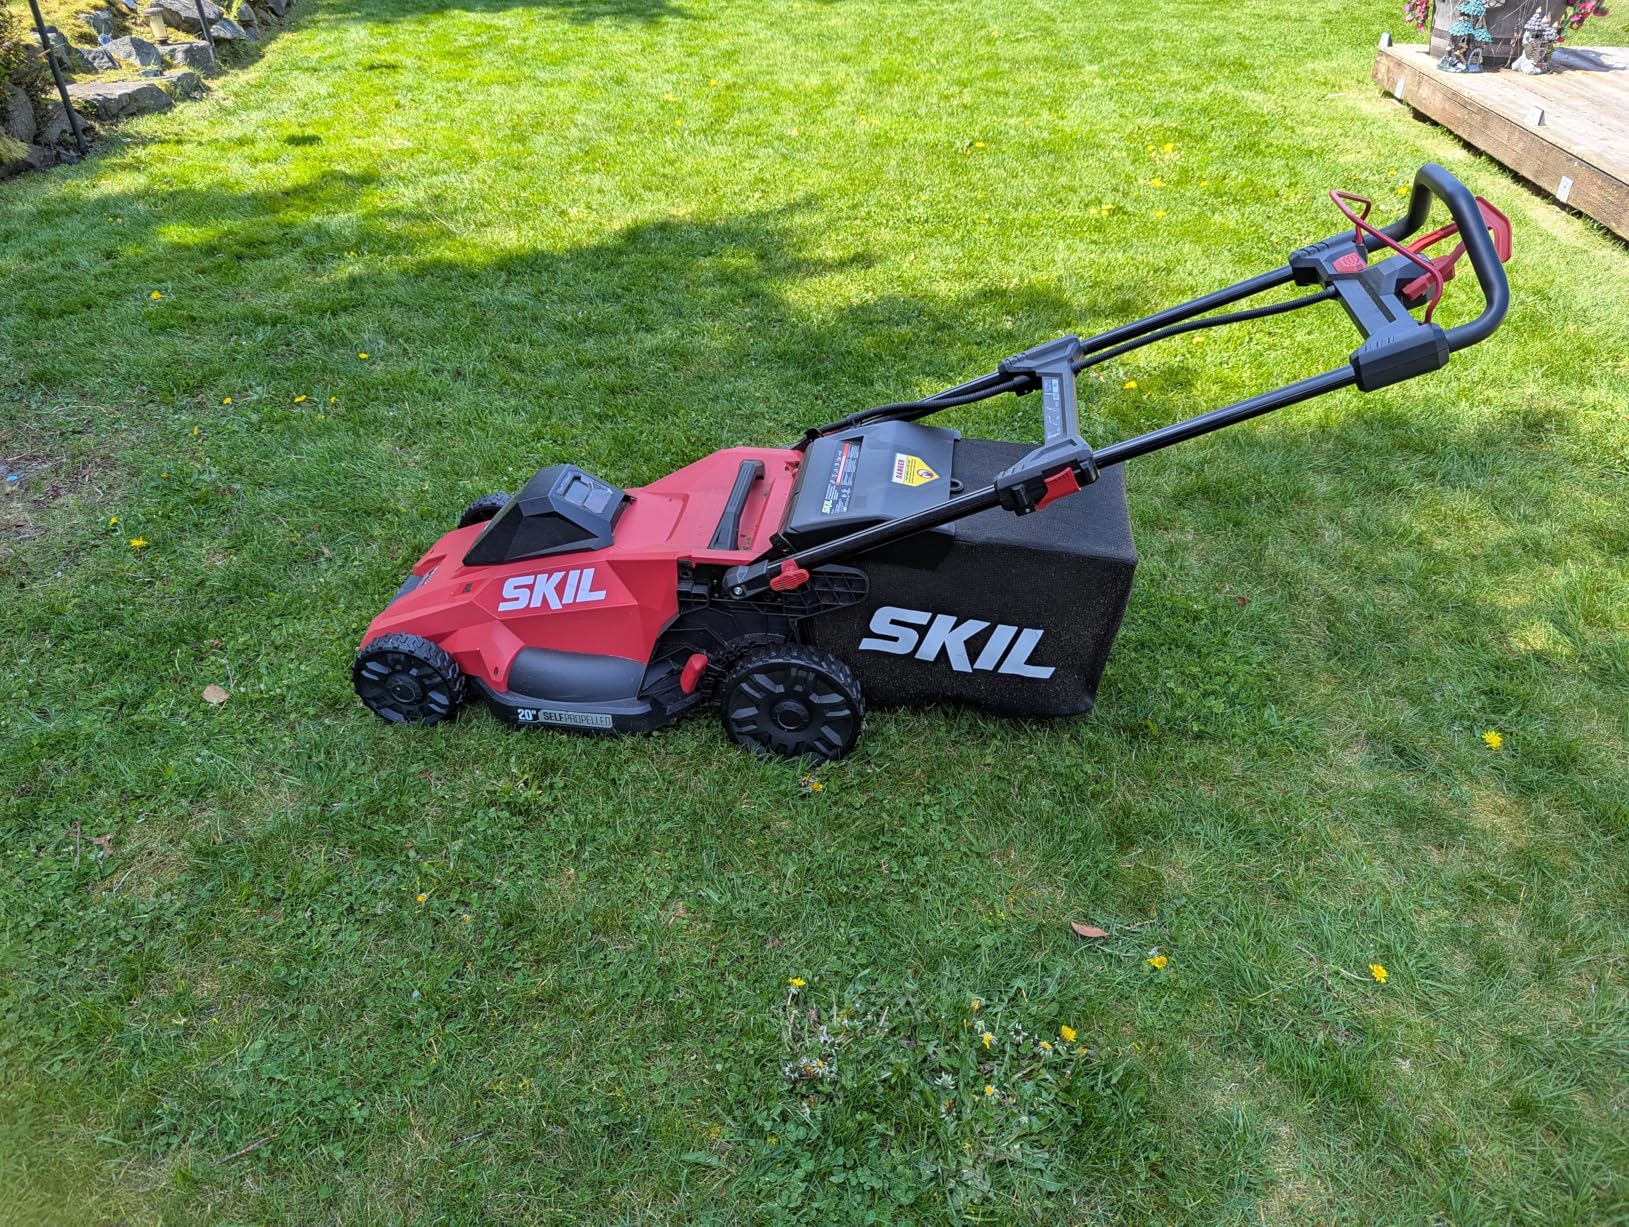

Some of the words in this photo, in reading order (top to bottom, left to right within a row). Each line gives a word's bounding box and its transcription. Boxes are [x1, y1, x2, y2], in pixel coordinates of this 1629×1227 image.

[821, 499, 833, 514] SKIL
[498, 568, 607, 612] SKIL
[858, 606, 1056, 679] SKIL
[517, 709, 537, 721] 20"
